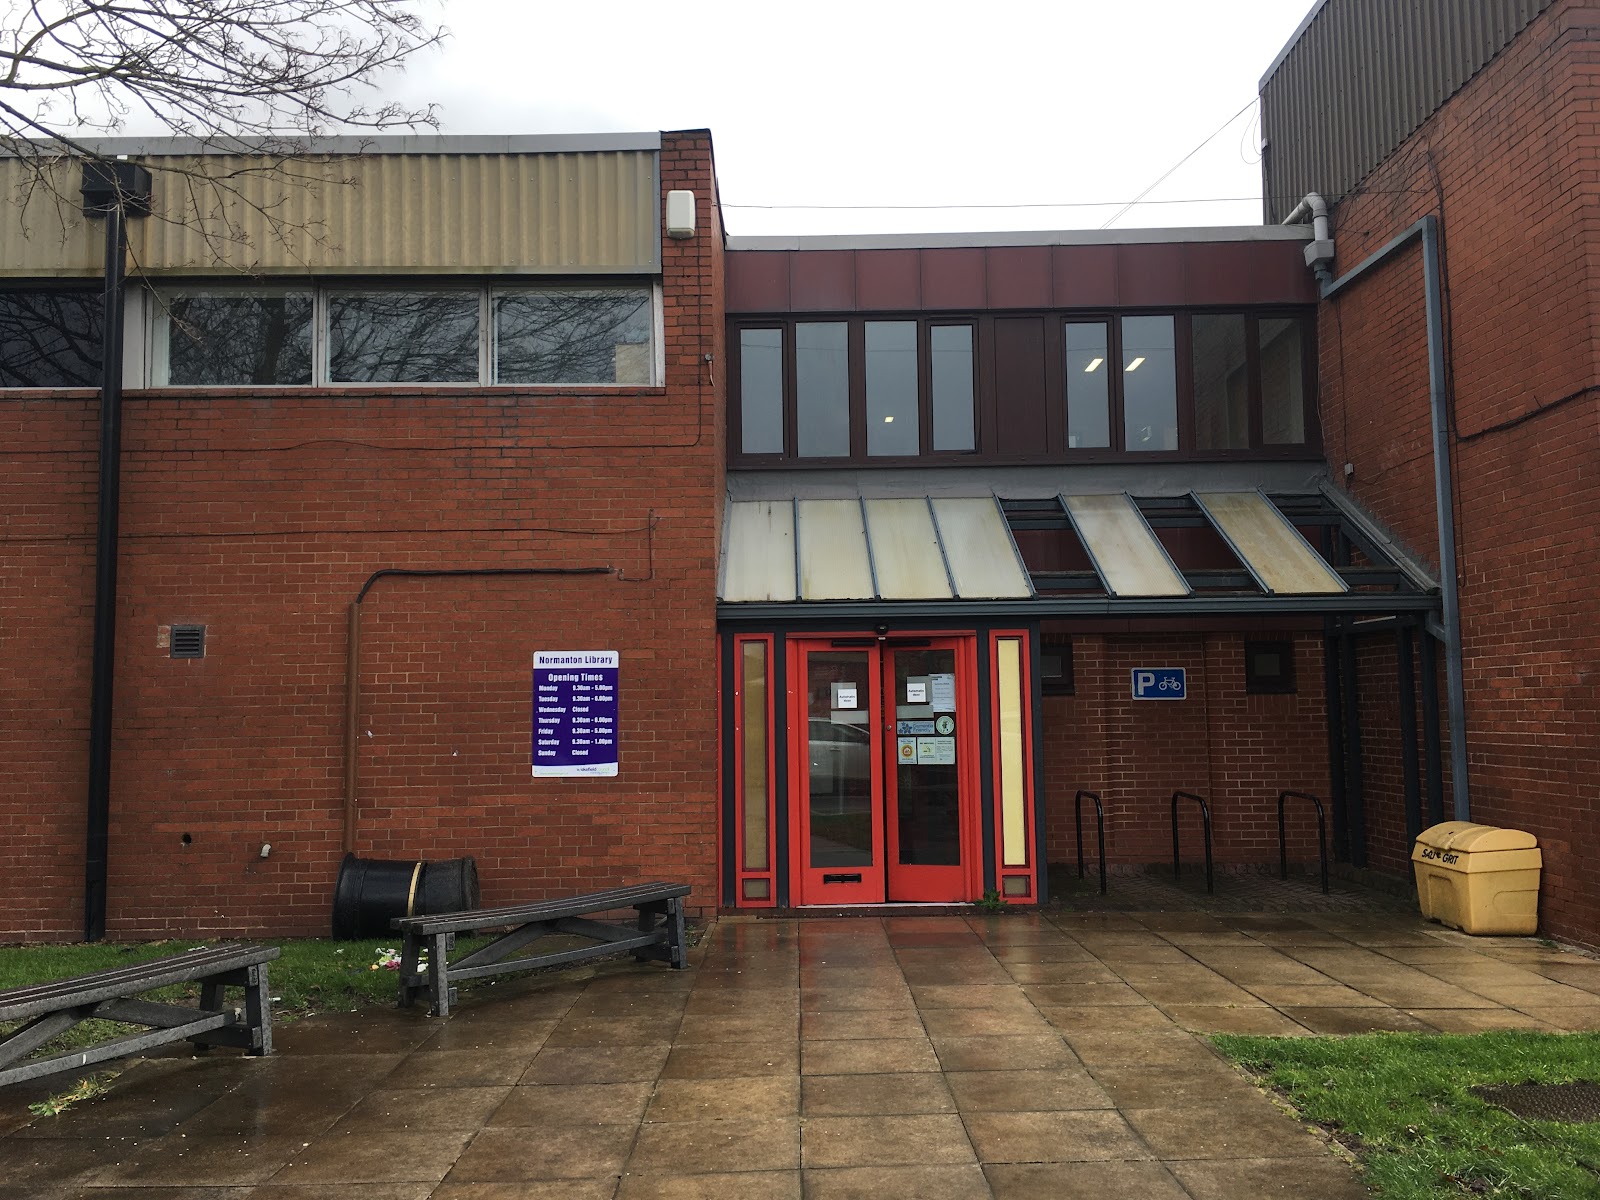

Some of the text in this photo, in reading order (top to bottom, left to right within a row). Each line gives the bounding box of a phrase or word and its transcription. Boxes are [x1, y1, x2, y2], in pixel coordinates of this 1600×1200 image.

[539, 656, 612, 664] Normanton Library
[548, 673, 603, 682] Opening Times
[1137, 672, 1156, 696] P
